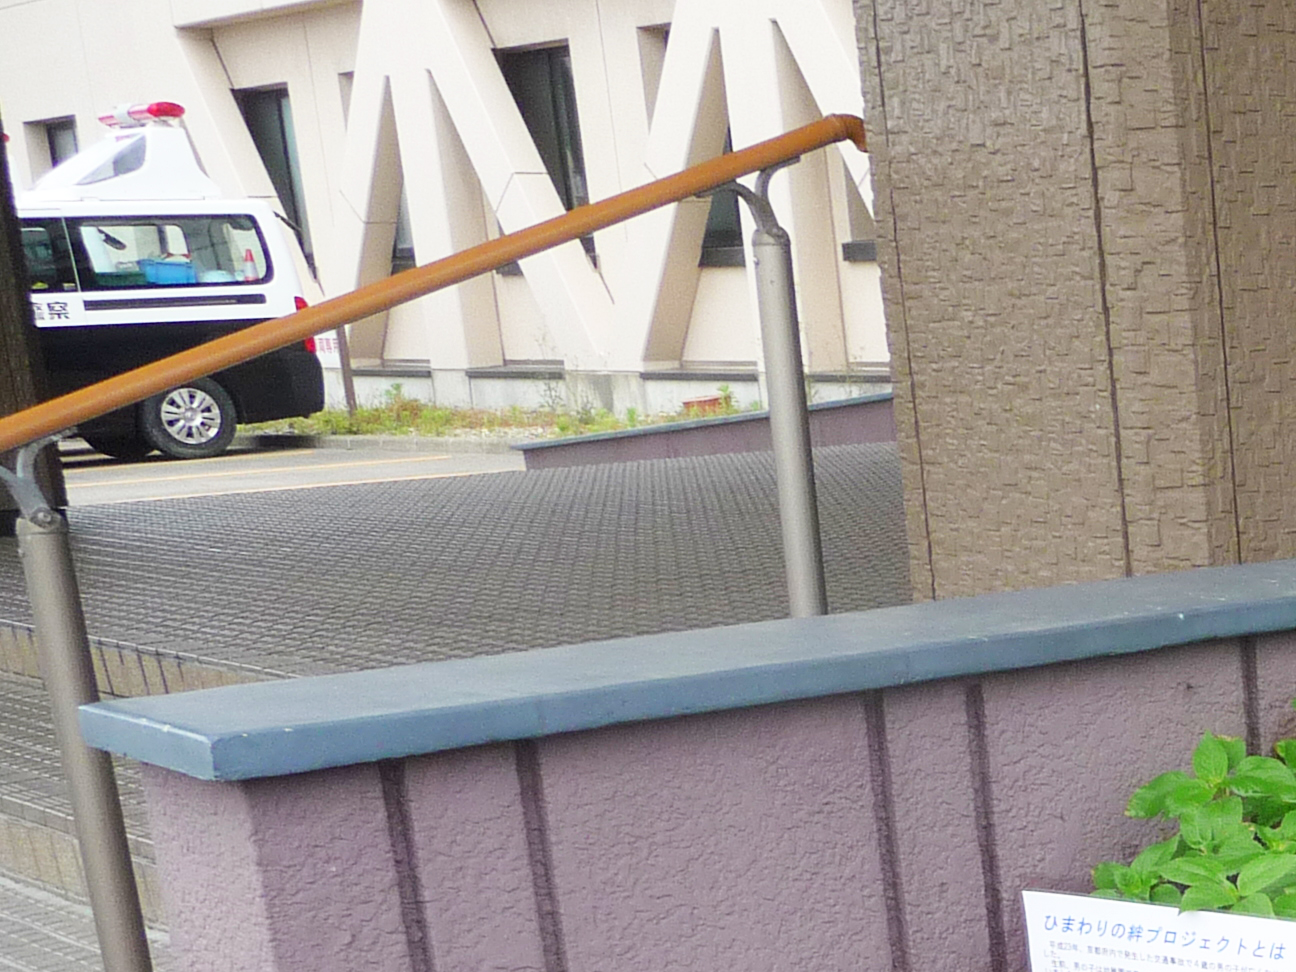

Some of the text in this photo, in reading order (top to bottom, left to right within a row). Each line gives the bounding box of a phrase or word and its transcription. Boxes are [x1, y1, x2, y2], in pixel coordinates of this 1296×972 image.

[1044, 914, 1286, 960] ひまわりの絆プロジェクトとは
